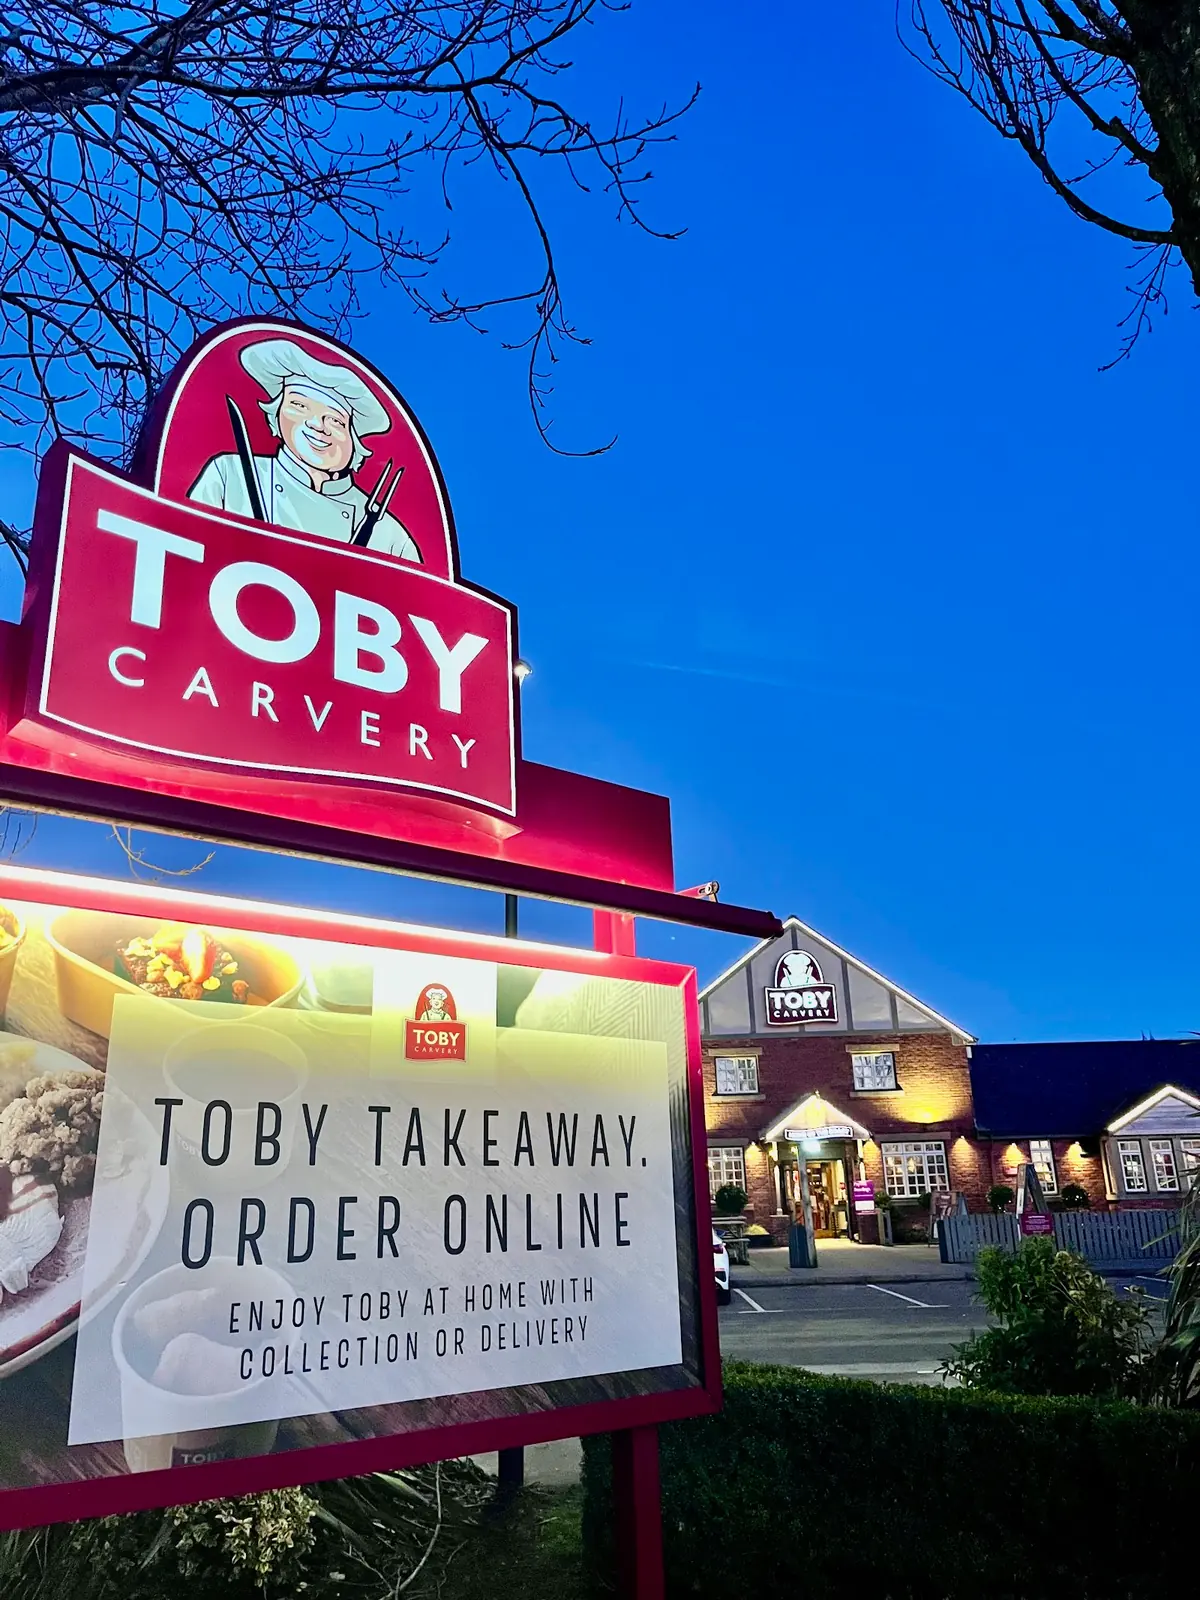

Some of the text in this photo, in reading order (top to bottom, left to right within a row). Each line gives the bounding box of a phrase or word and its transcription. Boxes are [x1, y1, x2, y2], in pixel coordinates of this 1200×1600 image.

[97, 508, 489, 714] TOBY
[108, 646, 477, 769] CARVERY
[769, 990, 831, 1010] TOBY
[773, 1009, 830, 1018] CARVERY
[412, 1029, 460, 1047] TOBY
[414, 1046, 458, 1055] CARVERY
[154, 1097, 647, 1168] TOBY TAKEAWAY.
[181, 1191, 632, 1270] ORDER ONLINE
[229, 1276, 594, 1334] ENJOY TOBY AT HOME WITH
[239, 1315, 588, 1381] COLLECTION OR DELIVERY
